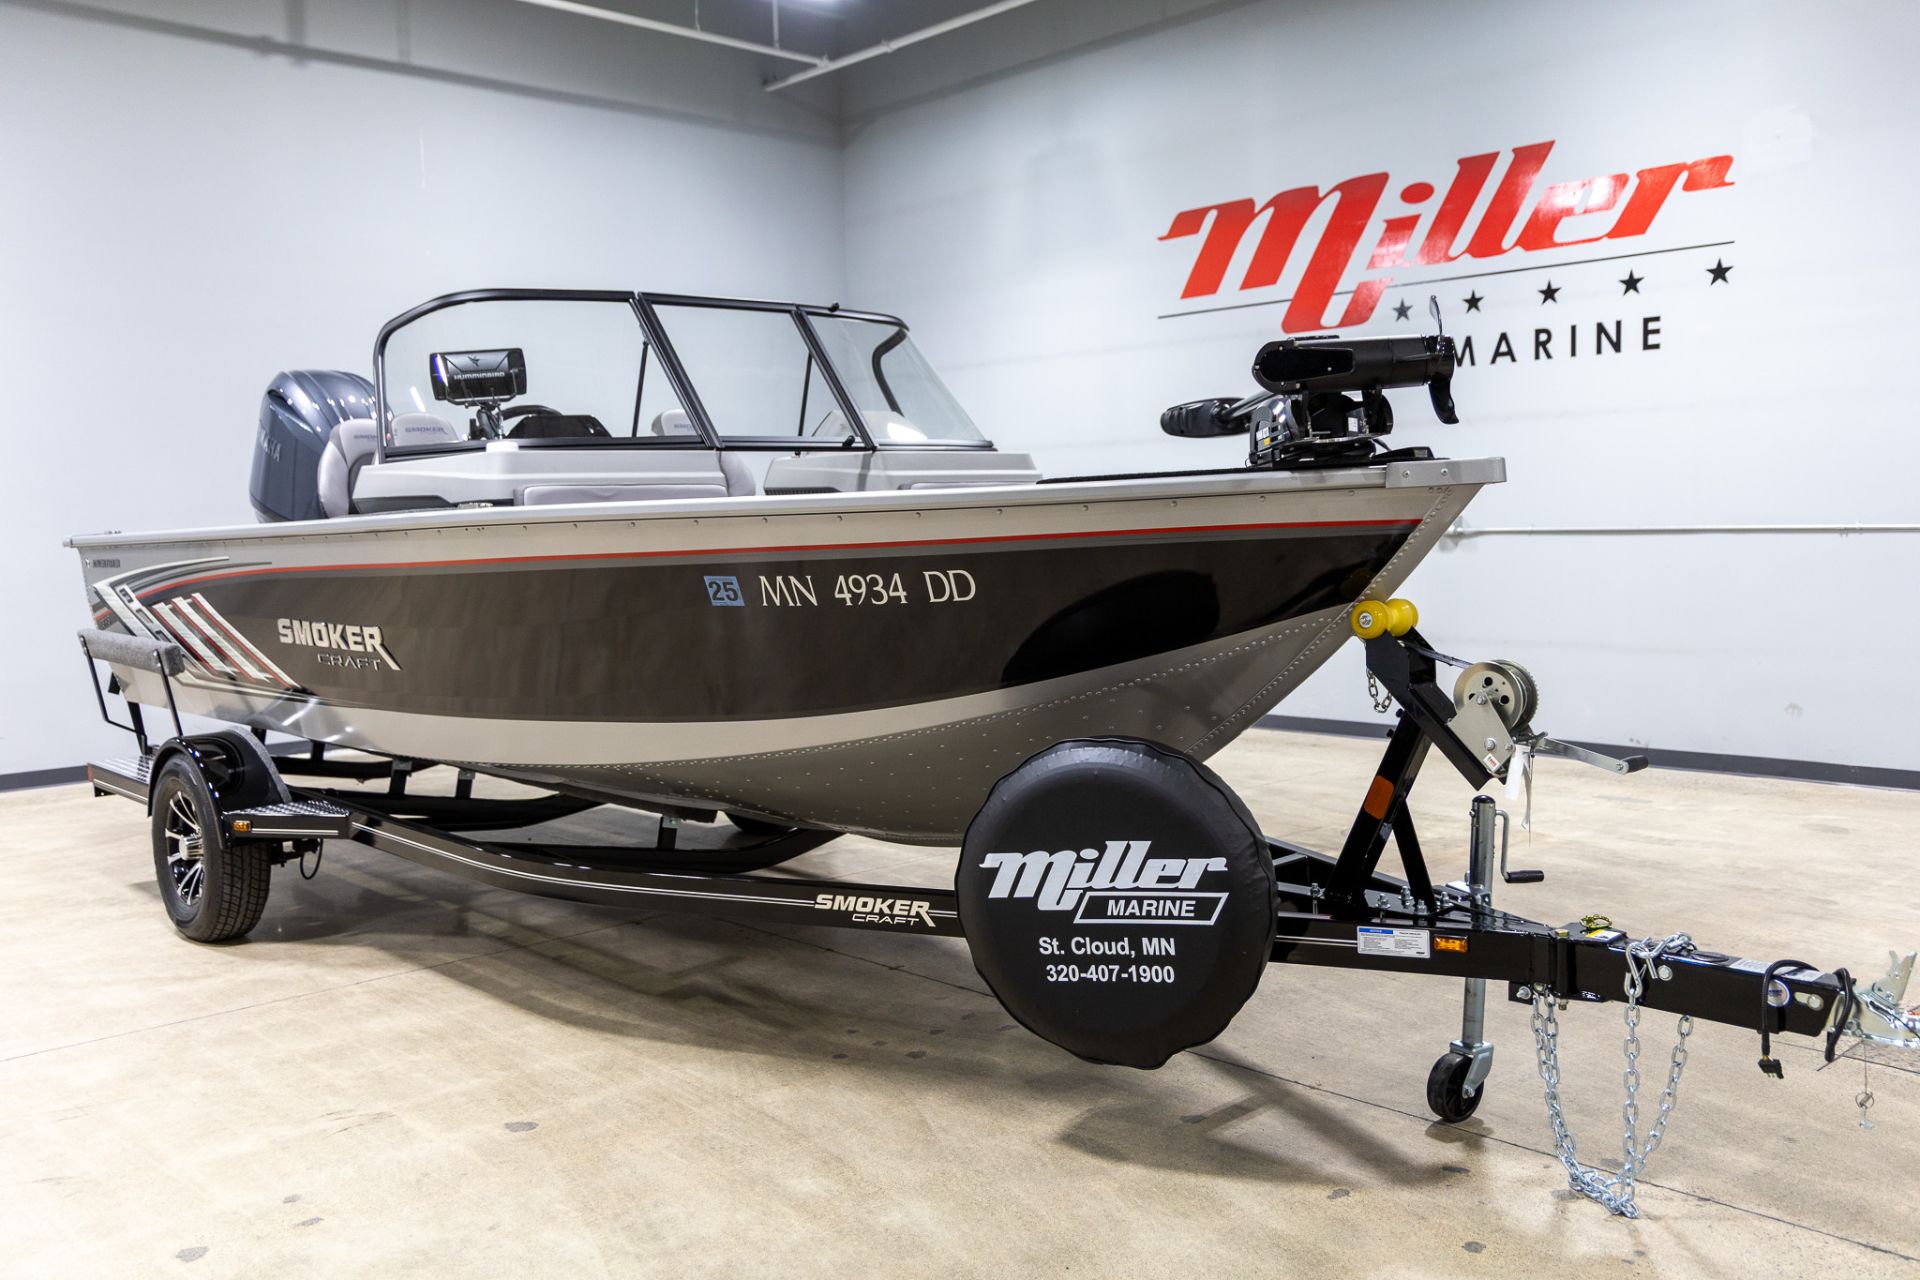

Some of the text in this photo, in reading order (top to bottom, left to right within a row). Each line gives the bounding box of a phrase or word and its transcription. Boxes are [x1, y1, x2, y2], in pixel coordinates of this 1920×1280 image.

[1452, 316, 1661, 367] MARINE
[708, 581, 739, 602] 25
[759, 570, 976, 606] MN 4934 DD
[277, 618, 402, 671] SMOKER
[317, 653, 381, 671] CRAFT
[814, 894, 936, 927] SMOKER
[1107, 900, 1196, 917] MARINE
[852, 913, 919, 926] CRAFT
[1039, 936, 1176, 958] St. Cloud, MN
[1046, 965, 1175, 983] 320-407-1900
